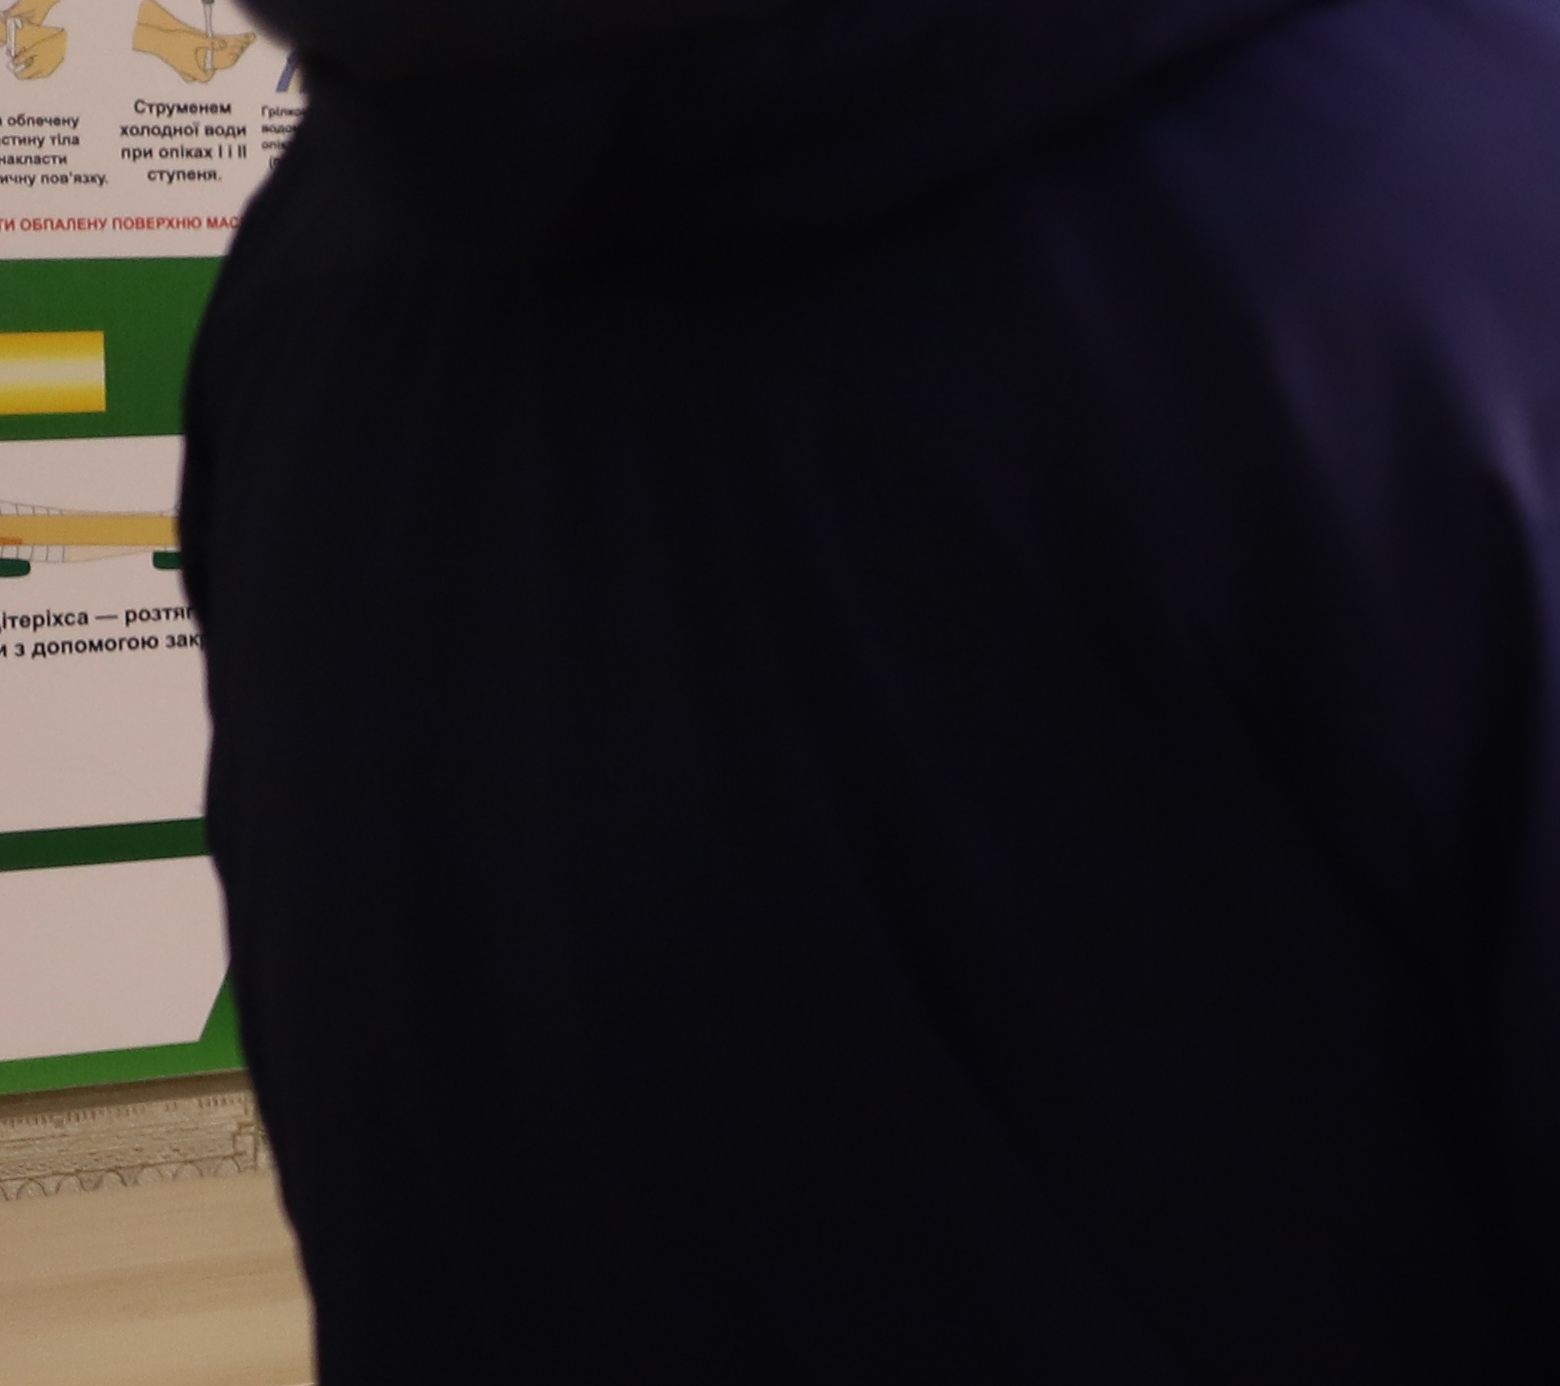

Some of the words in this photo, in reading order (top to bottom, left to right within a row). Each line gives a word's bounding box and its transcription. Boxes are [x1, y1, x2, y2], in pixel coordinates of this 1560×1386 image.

[134, 99, 232, 117] Струменем
[7, 113, 80, 129] обпечену
[120, 122, 198, 139] холодної
[204, 126, 247, 138] води
[49, 132, 80, 146] тіла
[121, 146, 152, 160] при
[158, 144, 212, 160] опіках
[40, 172, 109, 186] пов'язку.
[147, 169, 222, 185] ступеня.
[20, 218, 107, 231] ОБПАЛЕНУ
[113, 217, 202, 231] ПОВЕРХНЮ
[0, 610, 88, 633] ітеріхса
[31, 636, 159, 659] допомогою
